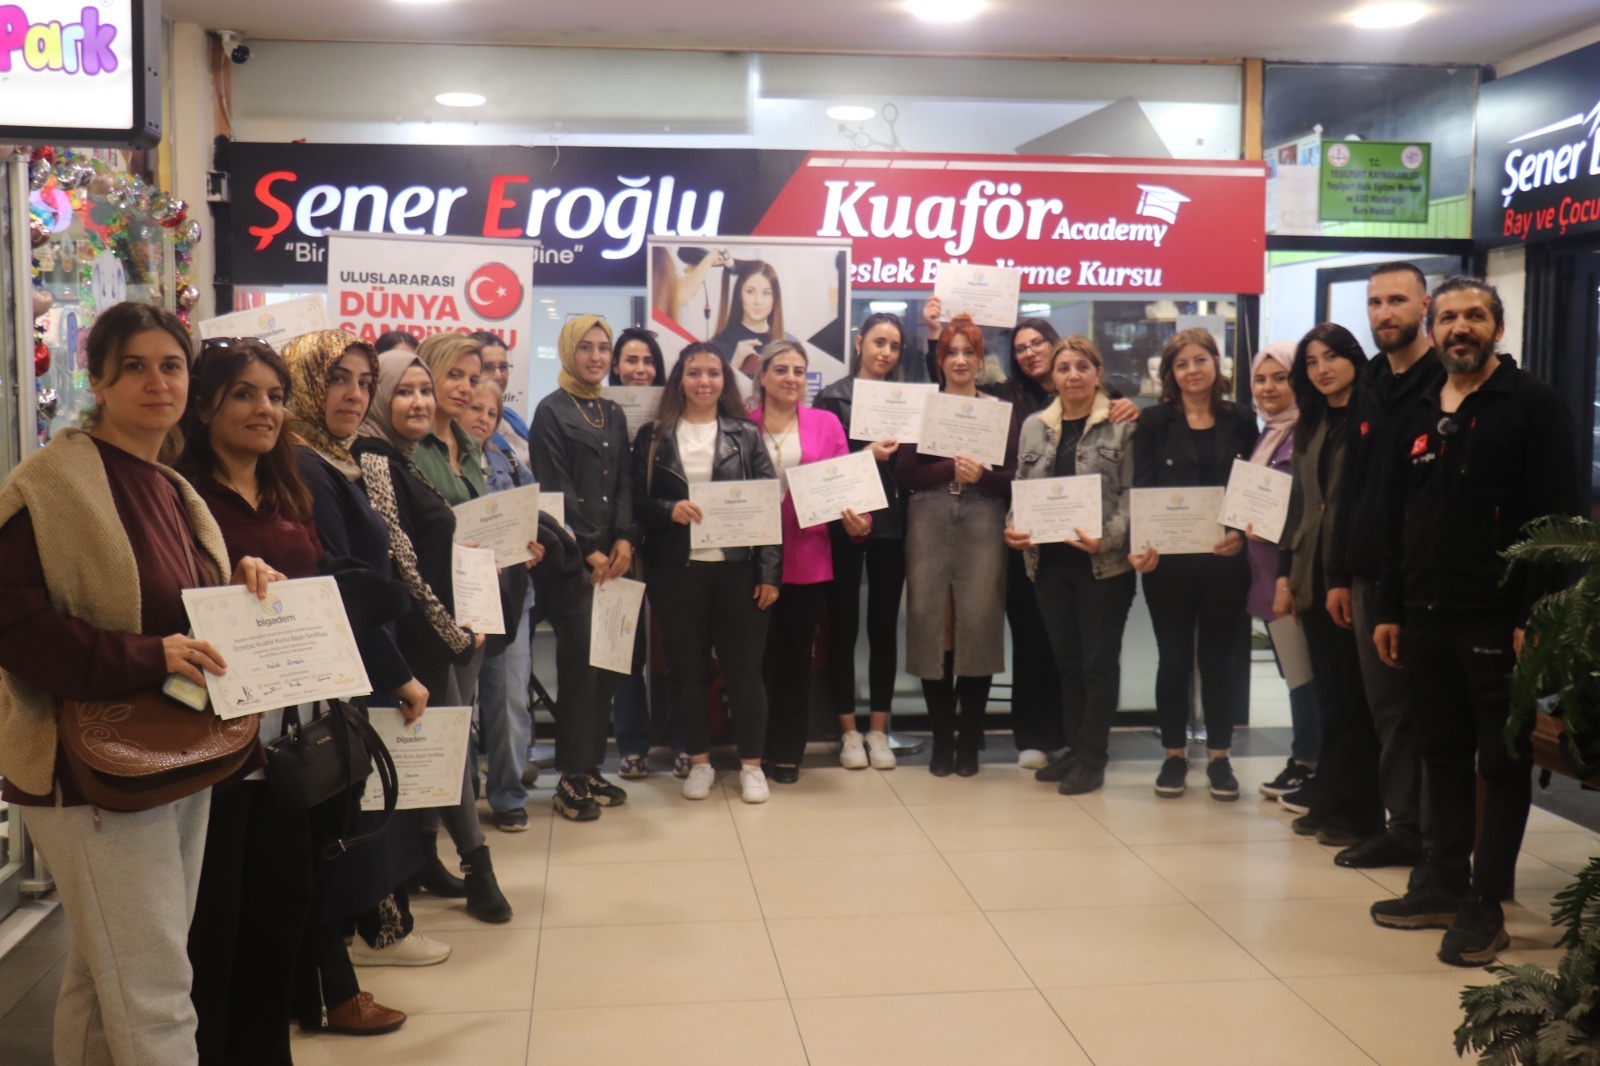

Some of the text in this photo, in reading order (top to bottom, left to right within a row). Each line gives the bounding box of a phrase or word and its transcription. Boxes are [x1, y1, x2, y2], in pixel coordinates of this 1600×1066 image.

[0, 4, 118, 76] Park
[1501, 140, 1587, 208] Şener
[249, 171, 725, 260] Şener Eroğlu
[817, 180, 1167, 256] Kuaför Academy
[1503, 208, 1533, 240] Bay
[1536, 206, 1556, 231] ve
[340, 270, 455, 288] ULUSLARARASI
[850, 257, 915, 283] eslek
[1077, 261, 1163, 287] Kursu
[340, 286, 460, 321] DÜNYA
[256, 615, 296, 627] bigadem
[396, 736, 427, 745] bigadem
